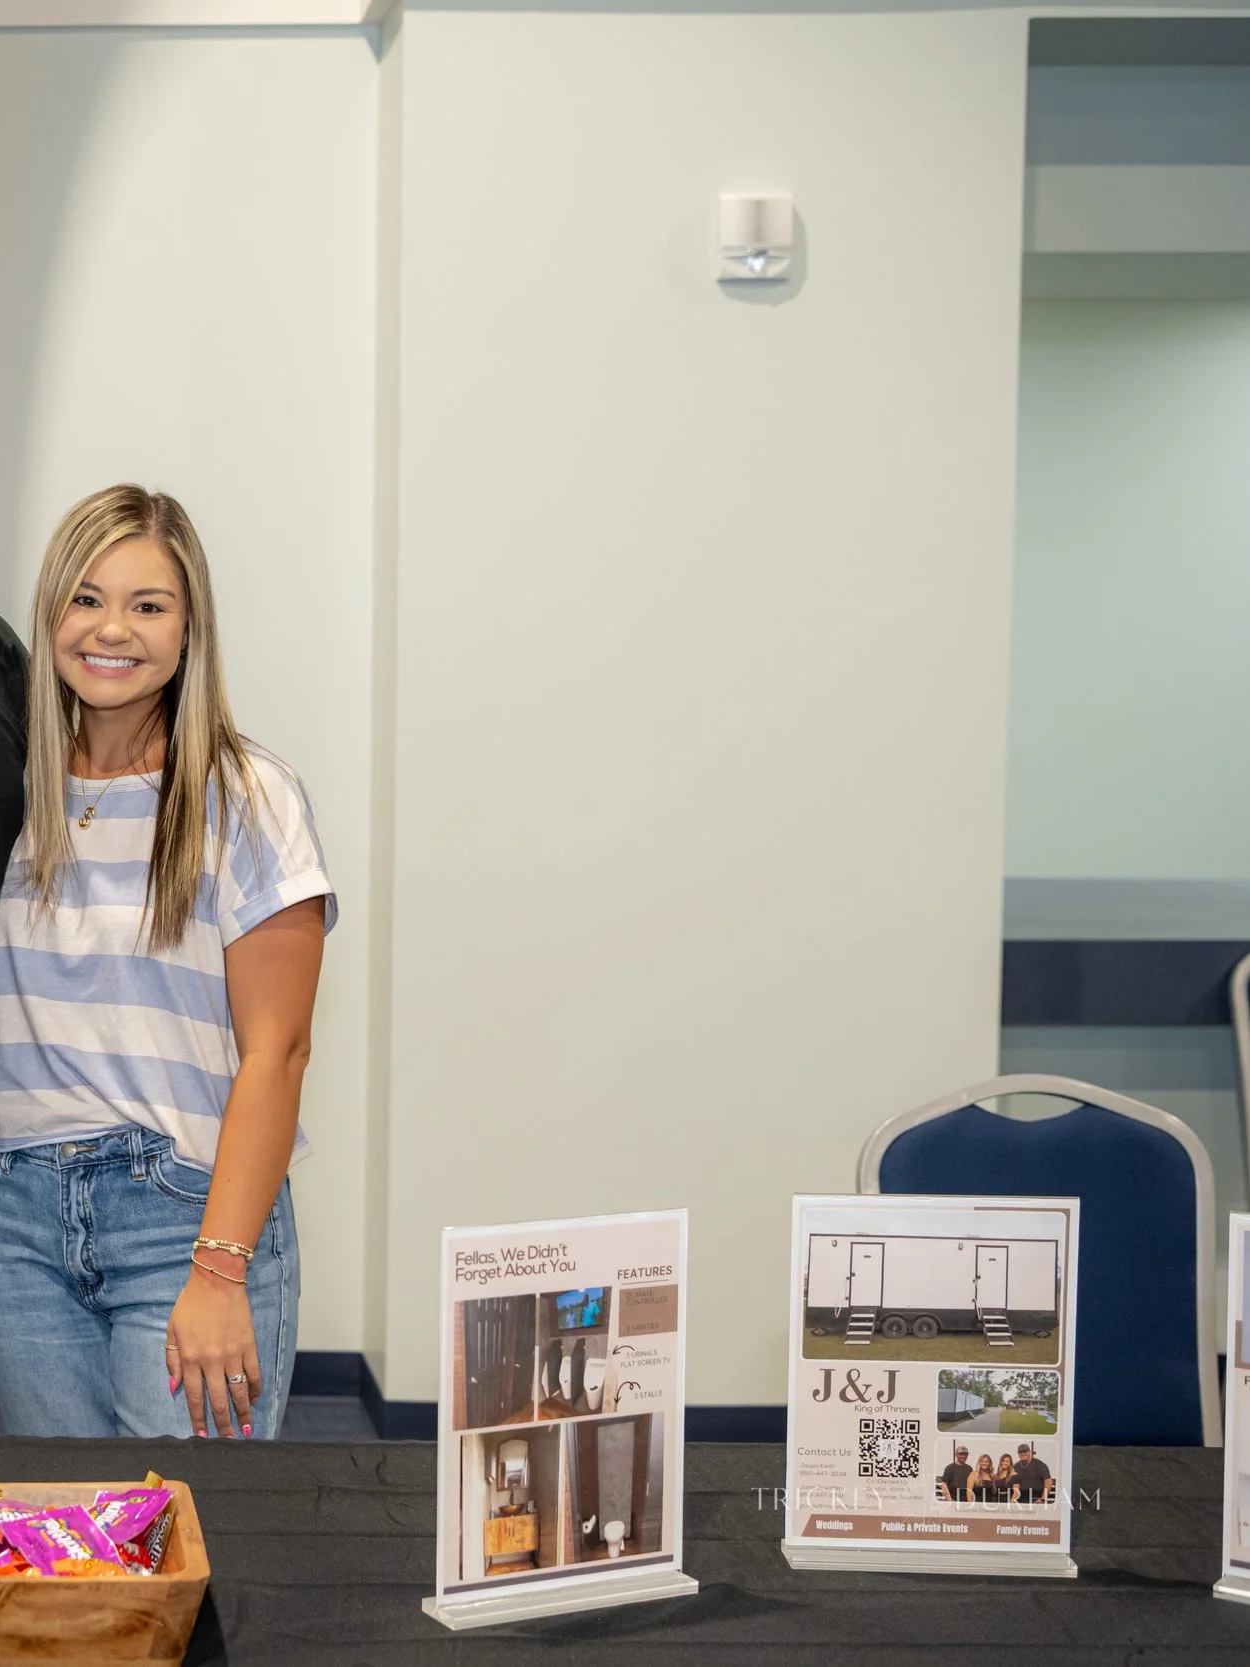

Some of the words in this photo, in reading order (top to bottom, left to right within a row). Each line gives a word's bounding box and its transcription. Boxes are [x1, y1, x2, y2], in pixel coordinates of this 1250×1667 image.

[500, 1247, 525, 1262] We
[527, 1243, 568, 1260] Didn't
[455, 1265, 502, 1285] Forget
[504, 1261, 547, 1277] About
[549, 1258, 576, 1273] You
[617, 1265, 672, 1280] FEATURES
[631, 1349, 658, 1358] URINALS
[620, 1360, 635, 1368] FLAT
[637, 1357, 662, 1367] SCREEN
[663, 1356, 671, 1364] TV
[812, 1368, 900, 1404] J&J
[639, 1390, 663, 1399] STALLS
[854, 1405, 873, 1414] King
[874, 1405, 884, 1413] of
[885, 1405, 920, 1414] Thrones
[797, 1447, 836, 1457] Contact
[839, 1448, 852, 1457] Us
[815, 1520, 854, 1531] Weddings
[881, 1522, 905, 1532] Public
[913, 1522, 941, 1533] Private
[942, 1523, 969, 1534] Events
[996, 1525, 1021, 1536] Family
[1023, 1526, 1050, 1536] Events
